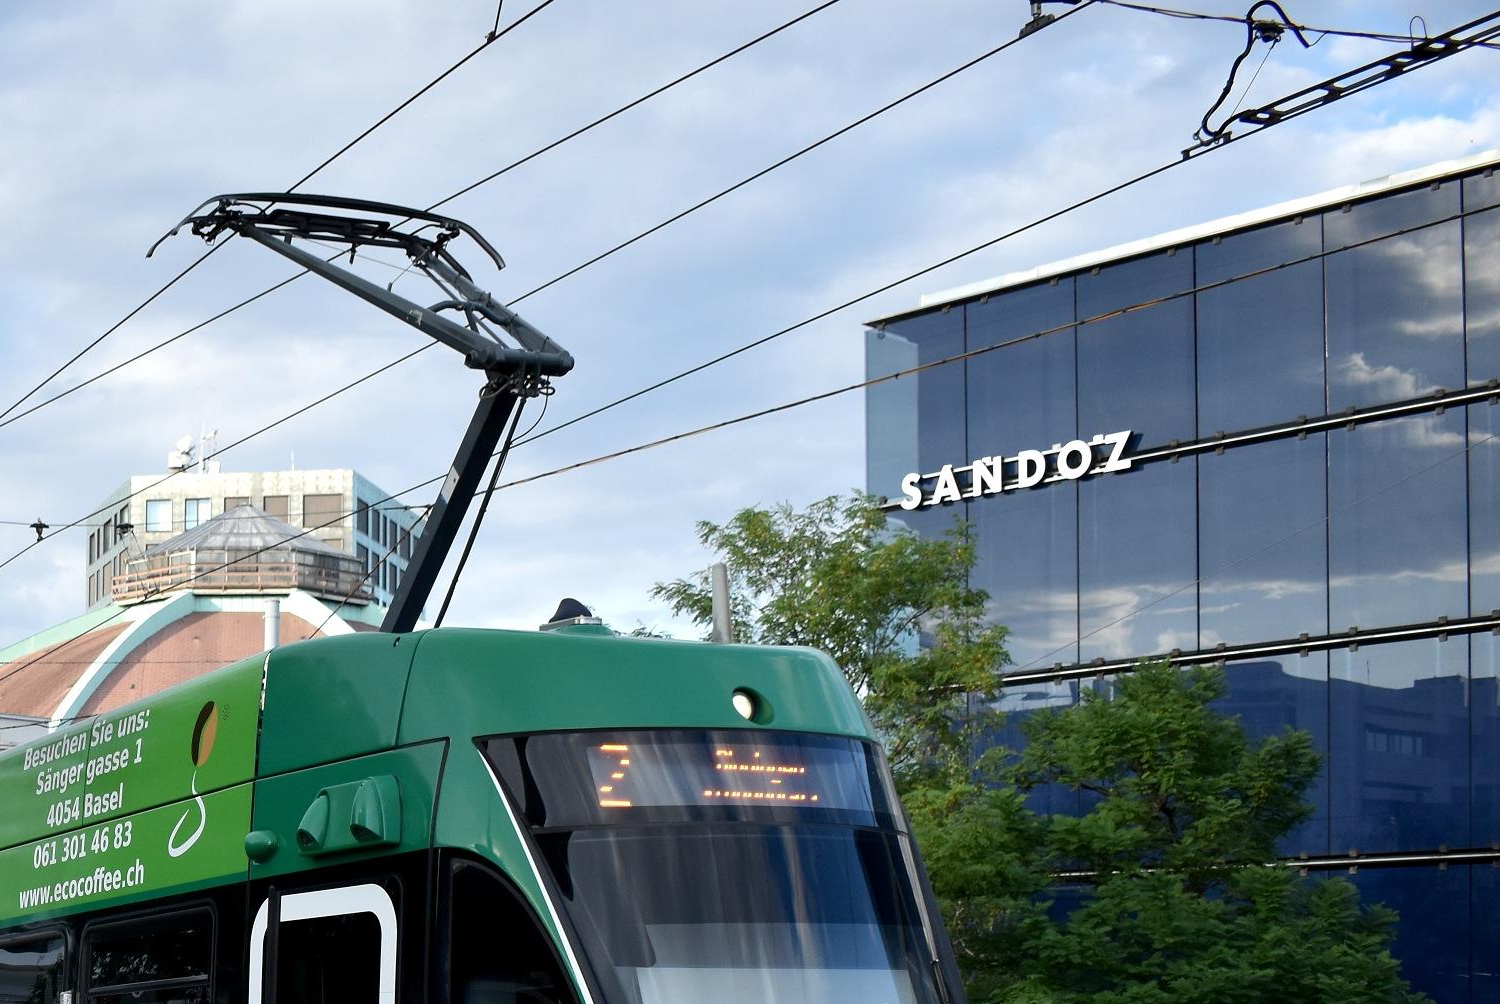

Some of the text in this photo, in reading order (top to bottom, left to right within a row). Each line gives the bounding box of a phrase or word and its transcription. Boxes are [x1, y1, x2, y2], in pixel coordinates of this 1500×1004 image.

[900, 430, 1132, 511] SANDOZ
[23, 709, 150, 771] Besuchen Sie uns:
[133, 738, 143, 764] 1
[46, 782, 125, 828] 4054 Basel
[33, 820, 133, 869] 061 301 46 83
[18, 858, 145, 909] www.ecocoffee.ch
